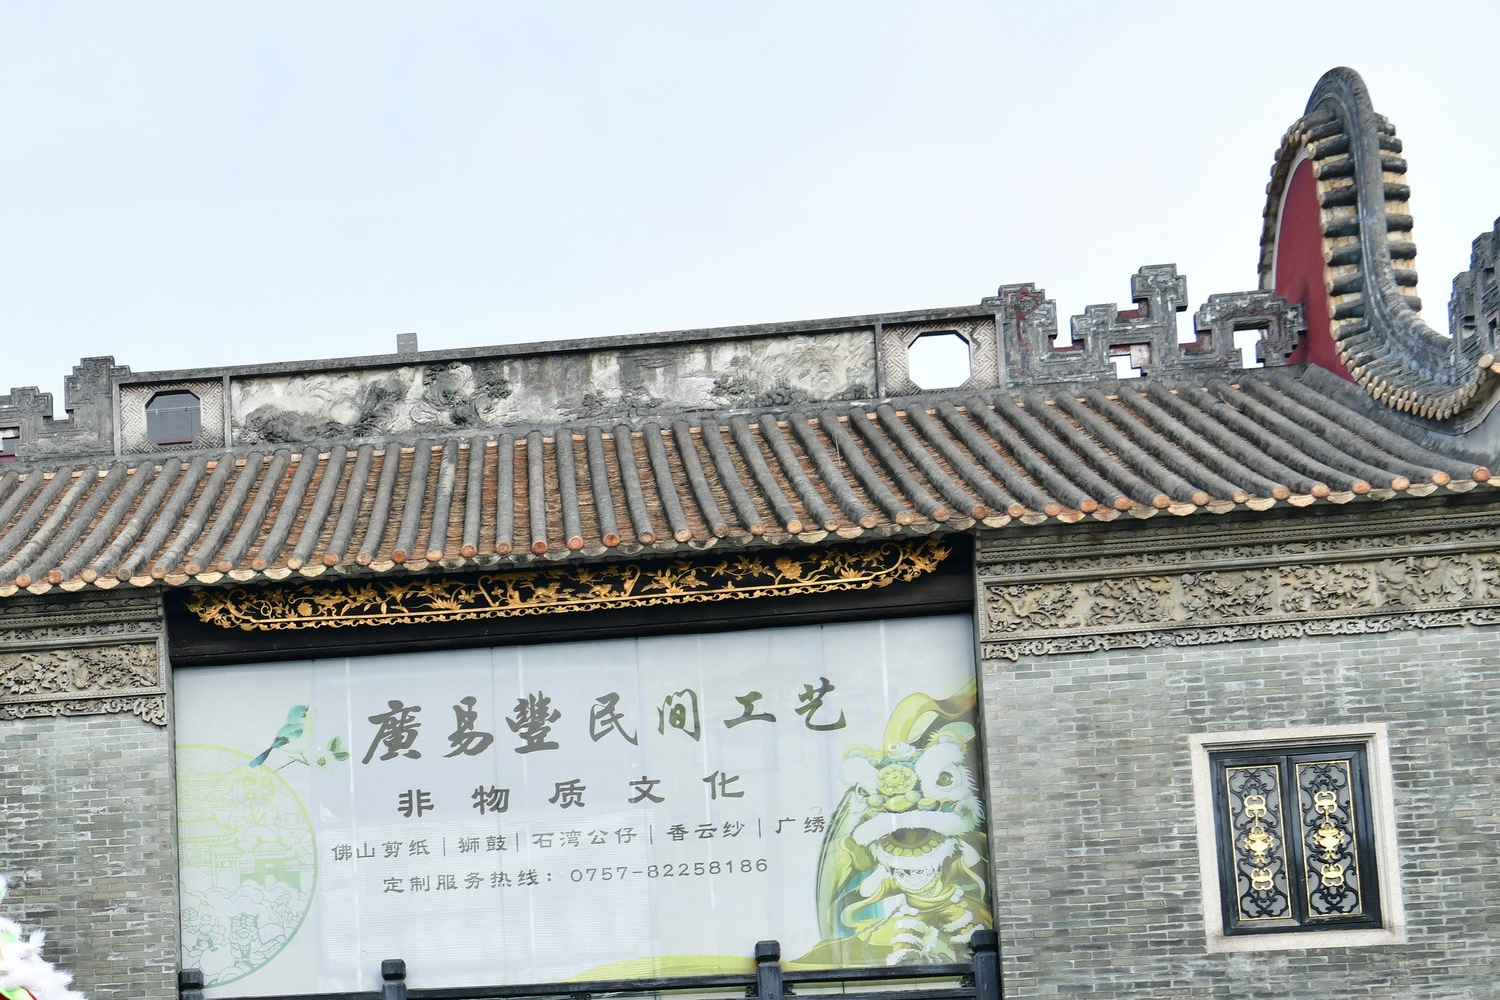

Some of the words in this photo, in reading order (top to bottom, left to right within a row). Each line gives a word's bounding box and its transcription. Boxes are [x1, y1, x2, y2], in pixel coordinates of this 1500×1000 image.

[362, 675, 848, 764] 廣易豐民间工艺
[398, 770, 746, 819] 非物质文化
[331, 837, 431, 862] 佛山剪纸
[458, 832, 508, 854] 狮鼓
[532, 825, 639, 850] 石湾公仔
[666, 819, 747, 843] 香云纱
[775, 813, 828, 837] 广绣
[570, 858, 769, 883] 0757-82258186
